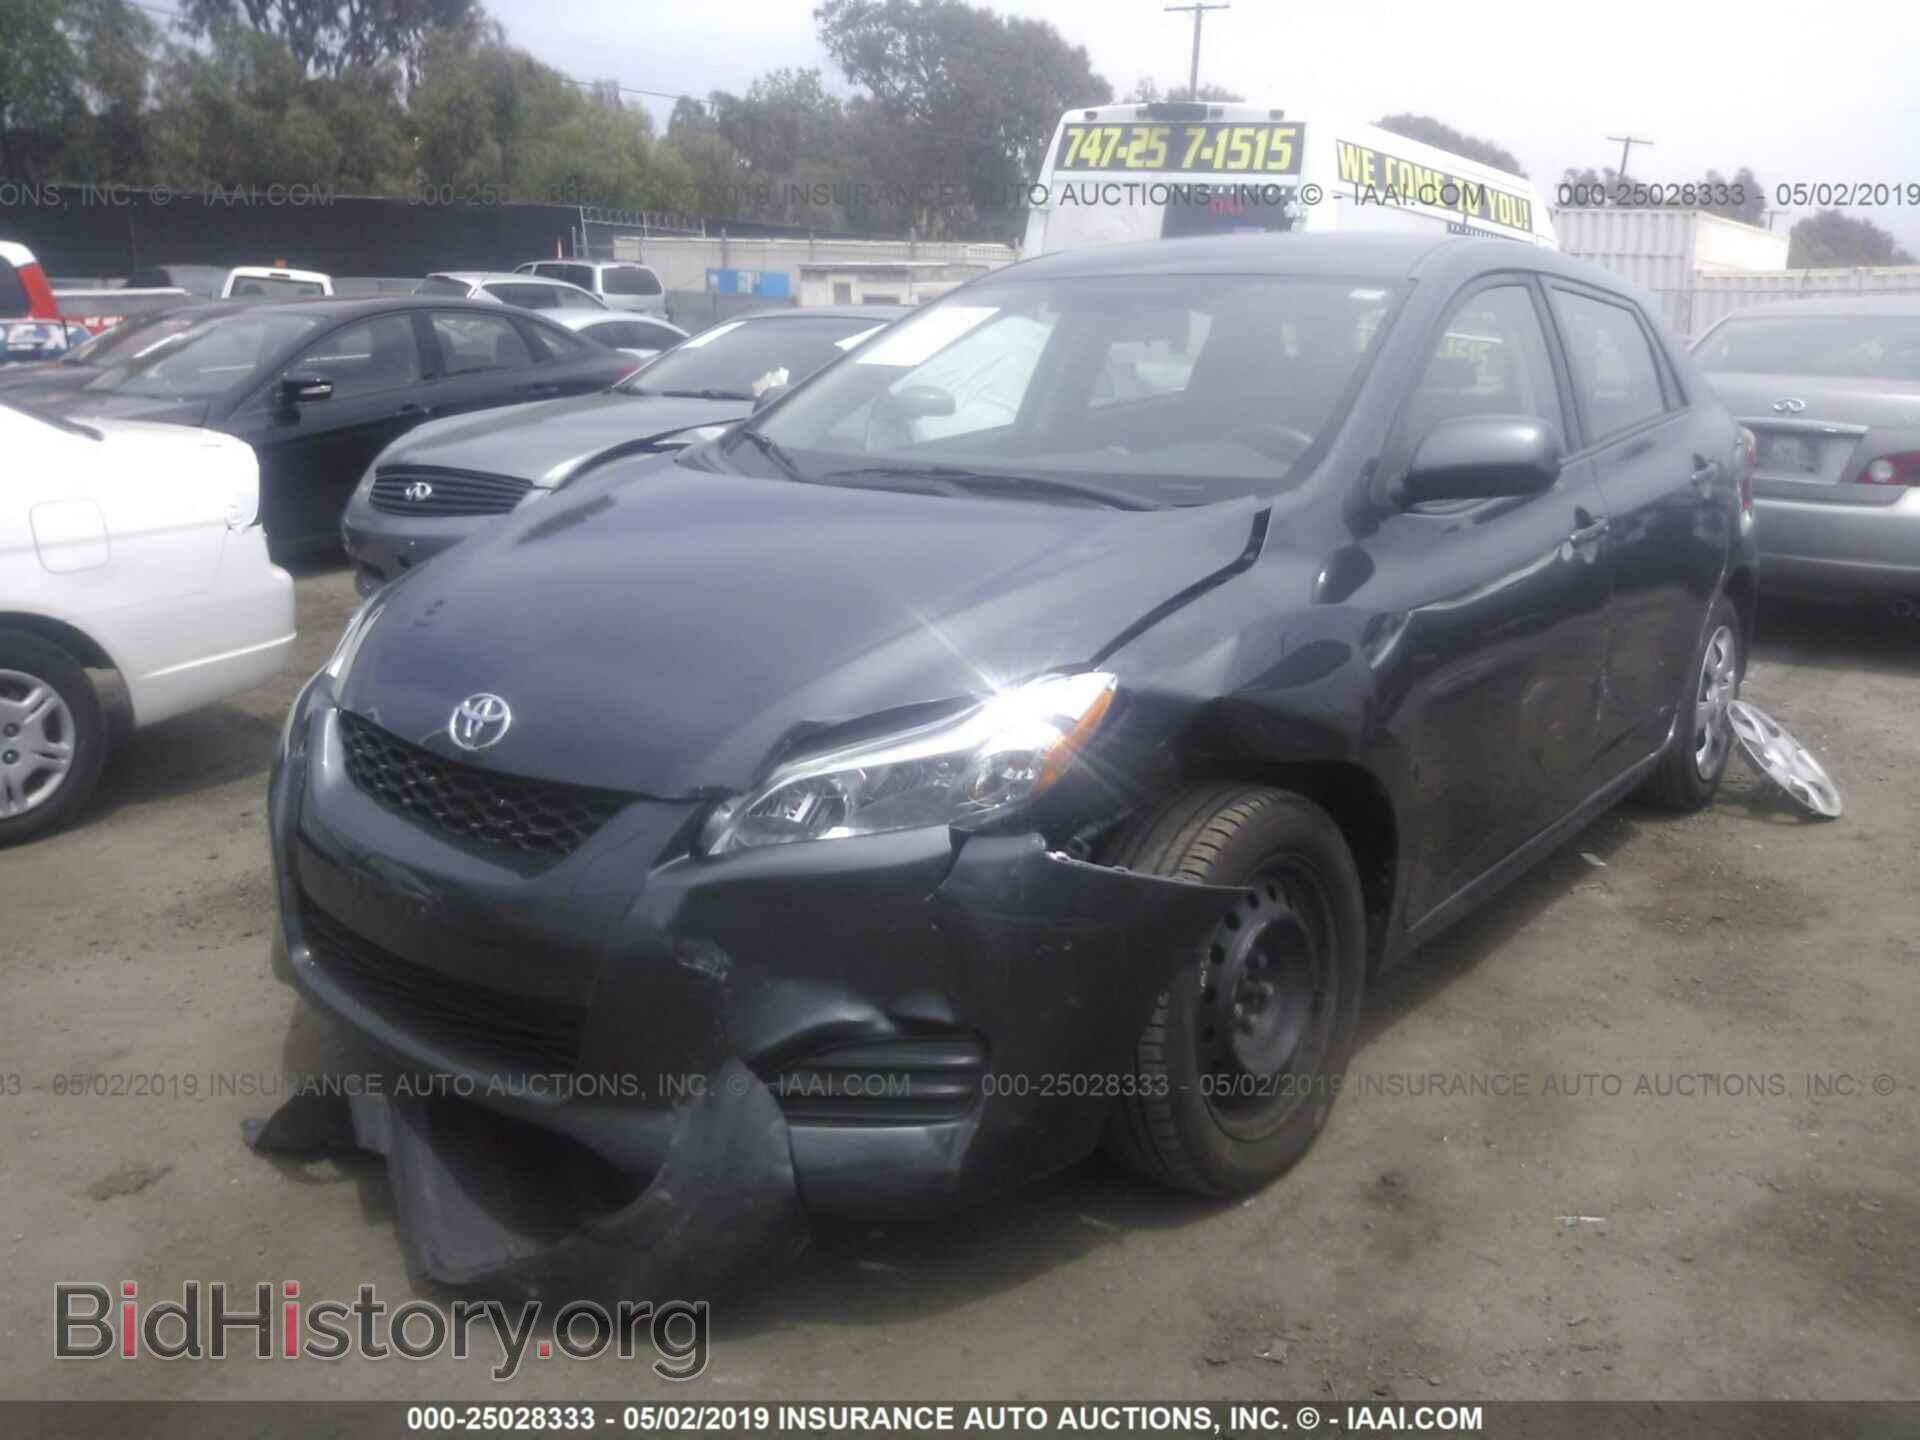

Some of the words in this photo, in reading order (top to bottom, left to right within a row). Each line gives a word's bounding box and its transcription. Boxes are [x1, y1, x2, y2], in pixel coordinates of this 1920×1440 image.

[1063, 127, 1170, 168] 747-25
[1181, 128, 1296, 170] 7-1515
[1337, 142, 1376, 186] WE
[1485, 187, 1531, 231] YOU!
